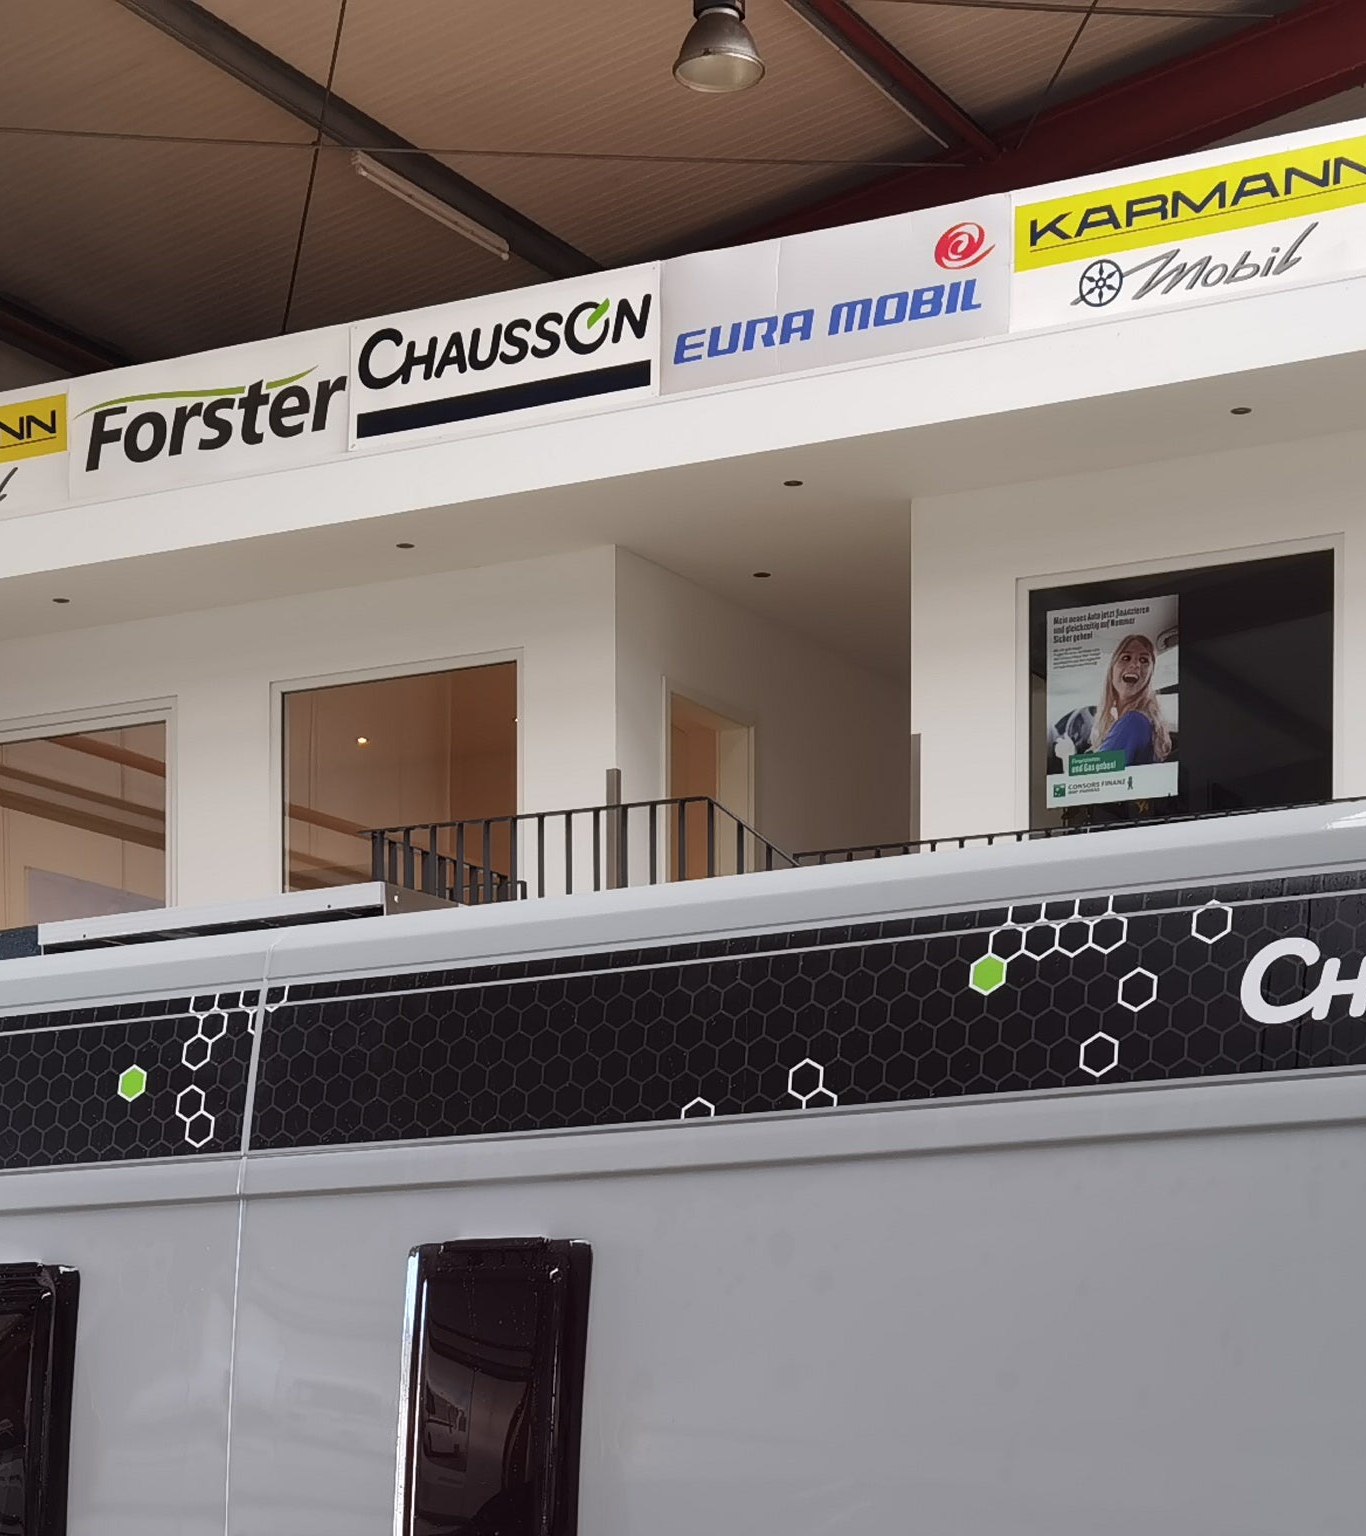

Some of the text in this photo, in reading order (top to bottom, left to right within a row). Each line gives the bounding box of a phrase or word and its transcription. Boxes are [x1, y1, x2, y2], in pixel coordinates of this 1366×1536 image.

[1124, 221, 1320, 302] Mobil
[358, 293, 652, 390] CHAUSSON
[673, 278, 982, 365] EURA MOBIL
[85, 372, 348, 473] Forster
